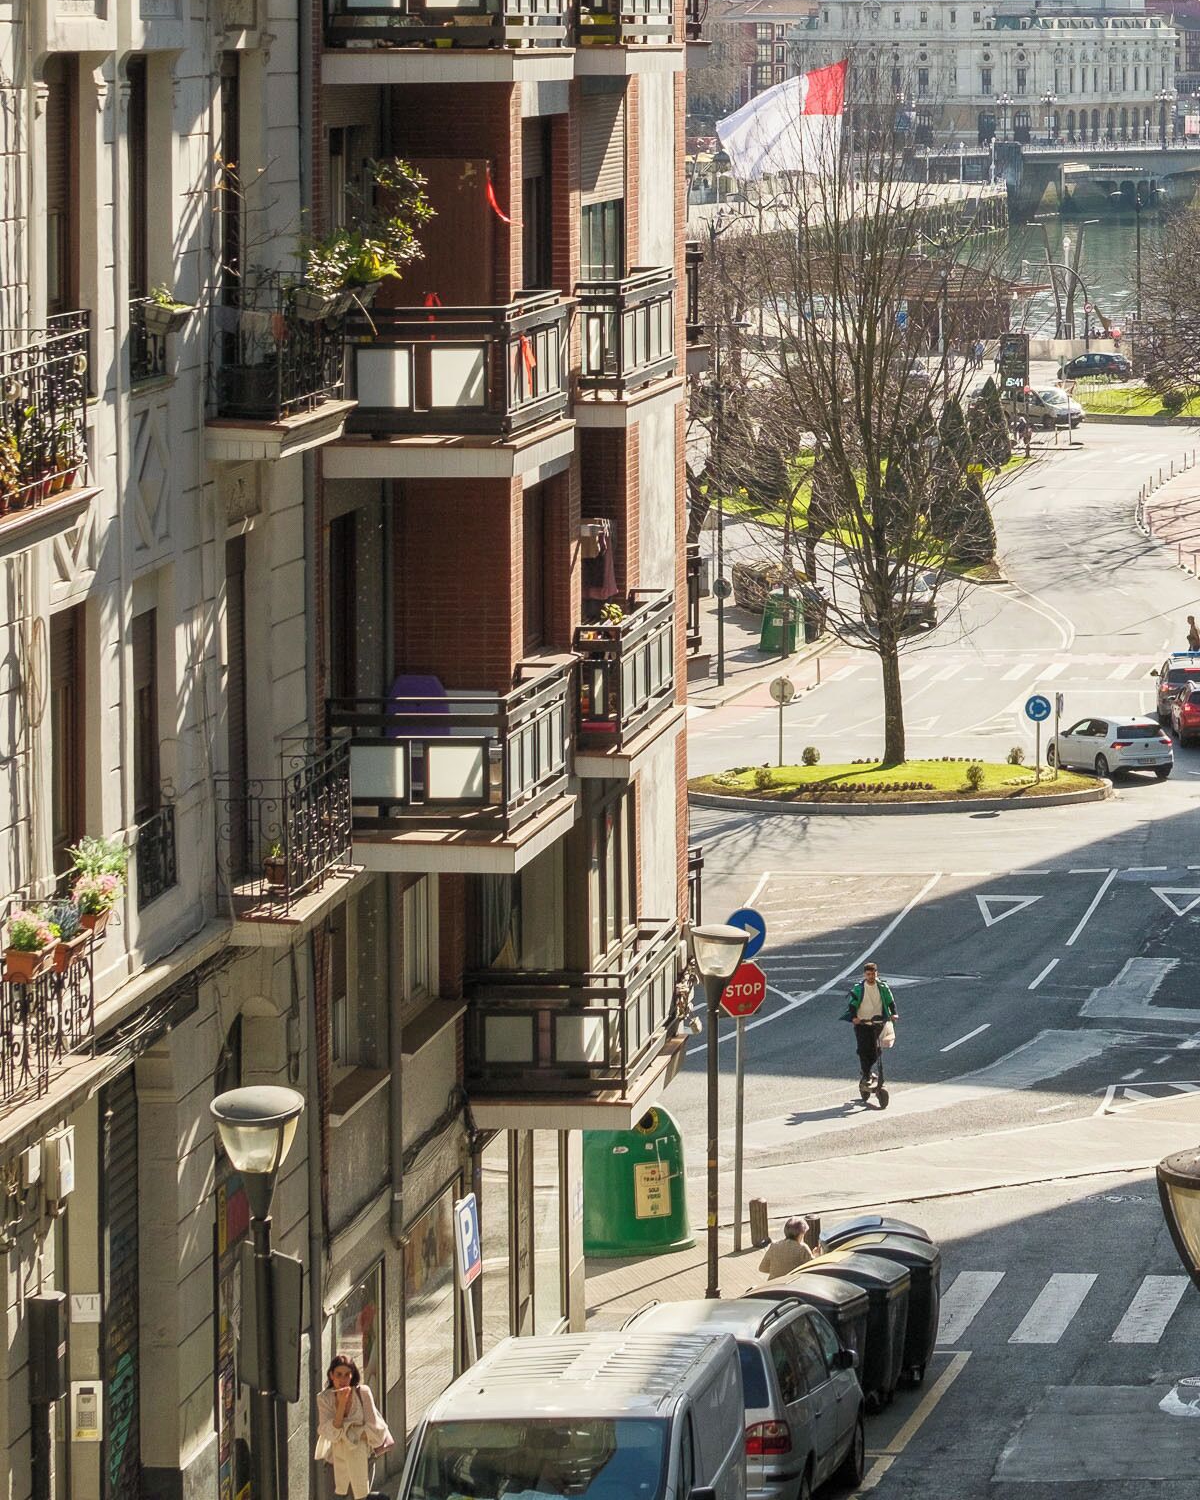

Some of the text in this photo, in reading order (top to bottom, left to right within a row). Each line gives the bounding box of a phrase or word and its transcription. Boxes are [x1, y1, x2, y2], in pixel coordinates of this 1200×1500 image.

[725, 982, 762, 998] STOP
[460, 1207, 473, 1271] P
[74, 1297, 98, 1311] VT
